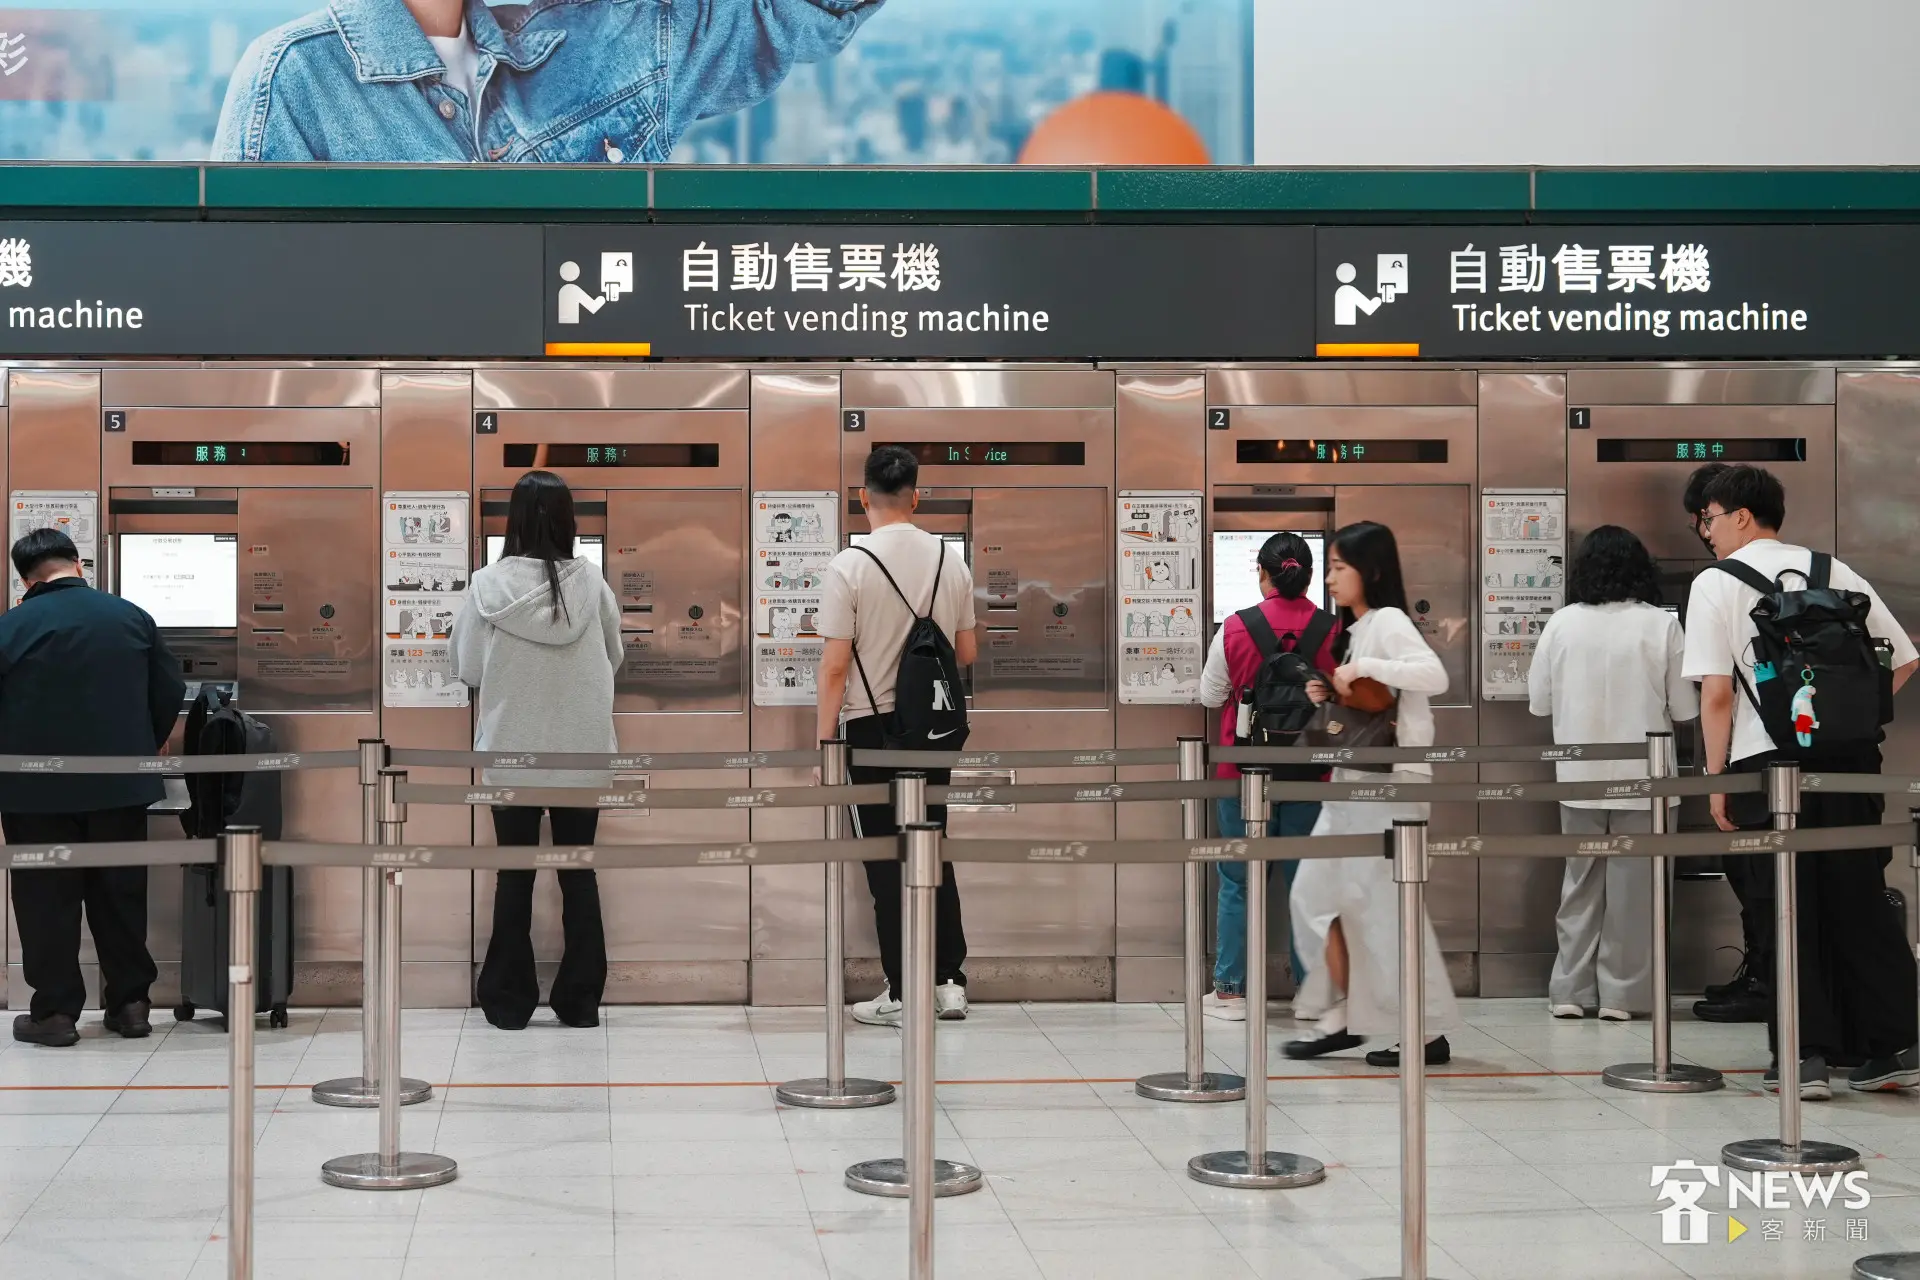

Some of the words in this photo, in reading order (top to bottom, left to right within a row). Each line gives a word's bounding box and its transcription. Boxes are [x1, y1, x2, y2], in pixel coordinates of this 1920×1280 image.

[0, 238, 32, 287] 機
[682, 241, 941, 292] 自動售票機
[1450, 243, 1711, 293] 自動售票機
[9, 299, 143, 328] machine
[684, 303, 775, 332] Ticket
[784, 302, 907, 338] vending
[918, 303, 1049, 332] machine
[1452, 303, 1541, 332] Ticket
[1548, 302, 1671, 337] vending
[1680, 302, 1808, 332] machine
[111, 414, 120, 428] 5
[482, 416, 492, 430] 4
[850, 413, 860, 428] 3
[1214, 412, 1225, 426] 2
[1576, 411, 1584, 425] 1
[196, 446, 245, 462] 服務
[586, 447, 626, 462] 服務
[948, 446, 960, 461] In
[964, 446, 1006, 461] Svice
[1676, 443, 1724, 459] 服務中
[425, 649, 448, 657] 一路好
[778, 648, 794, 656] 123
